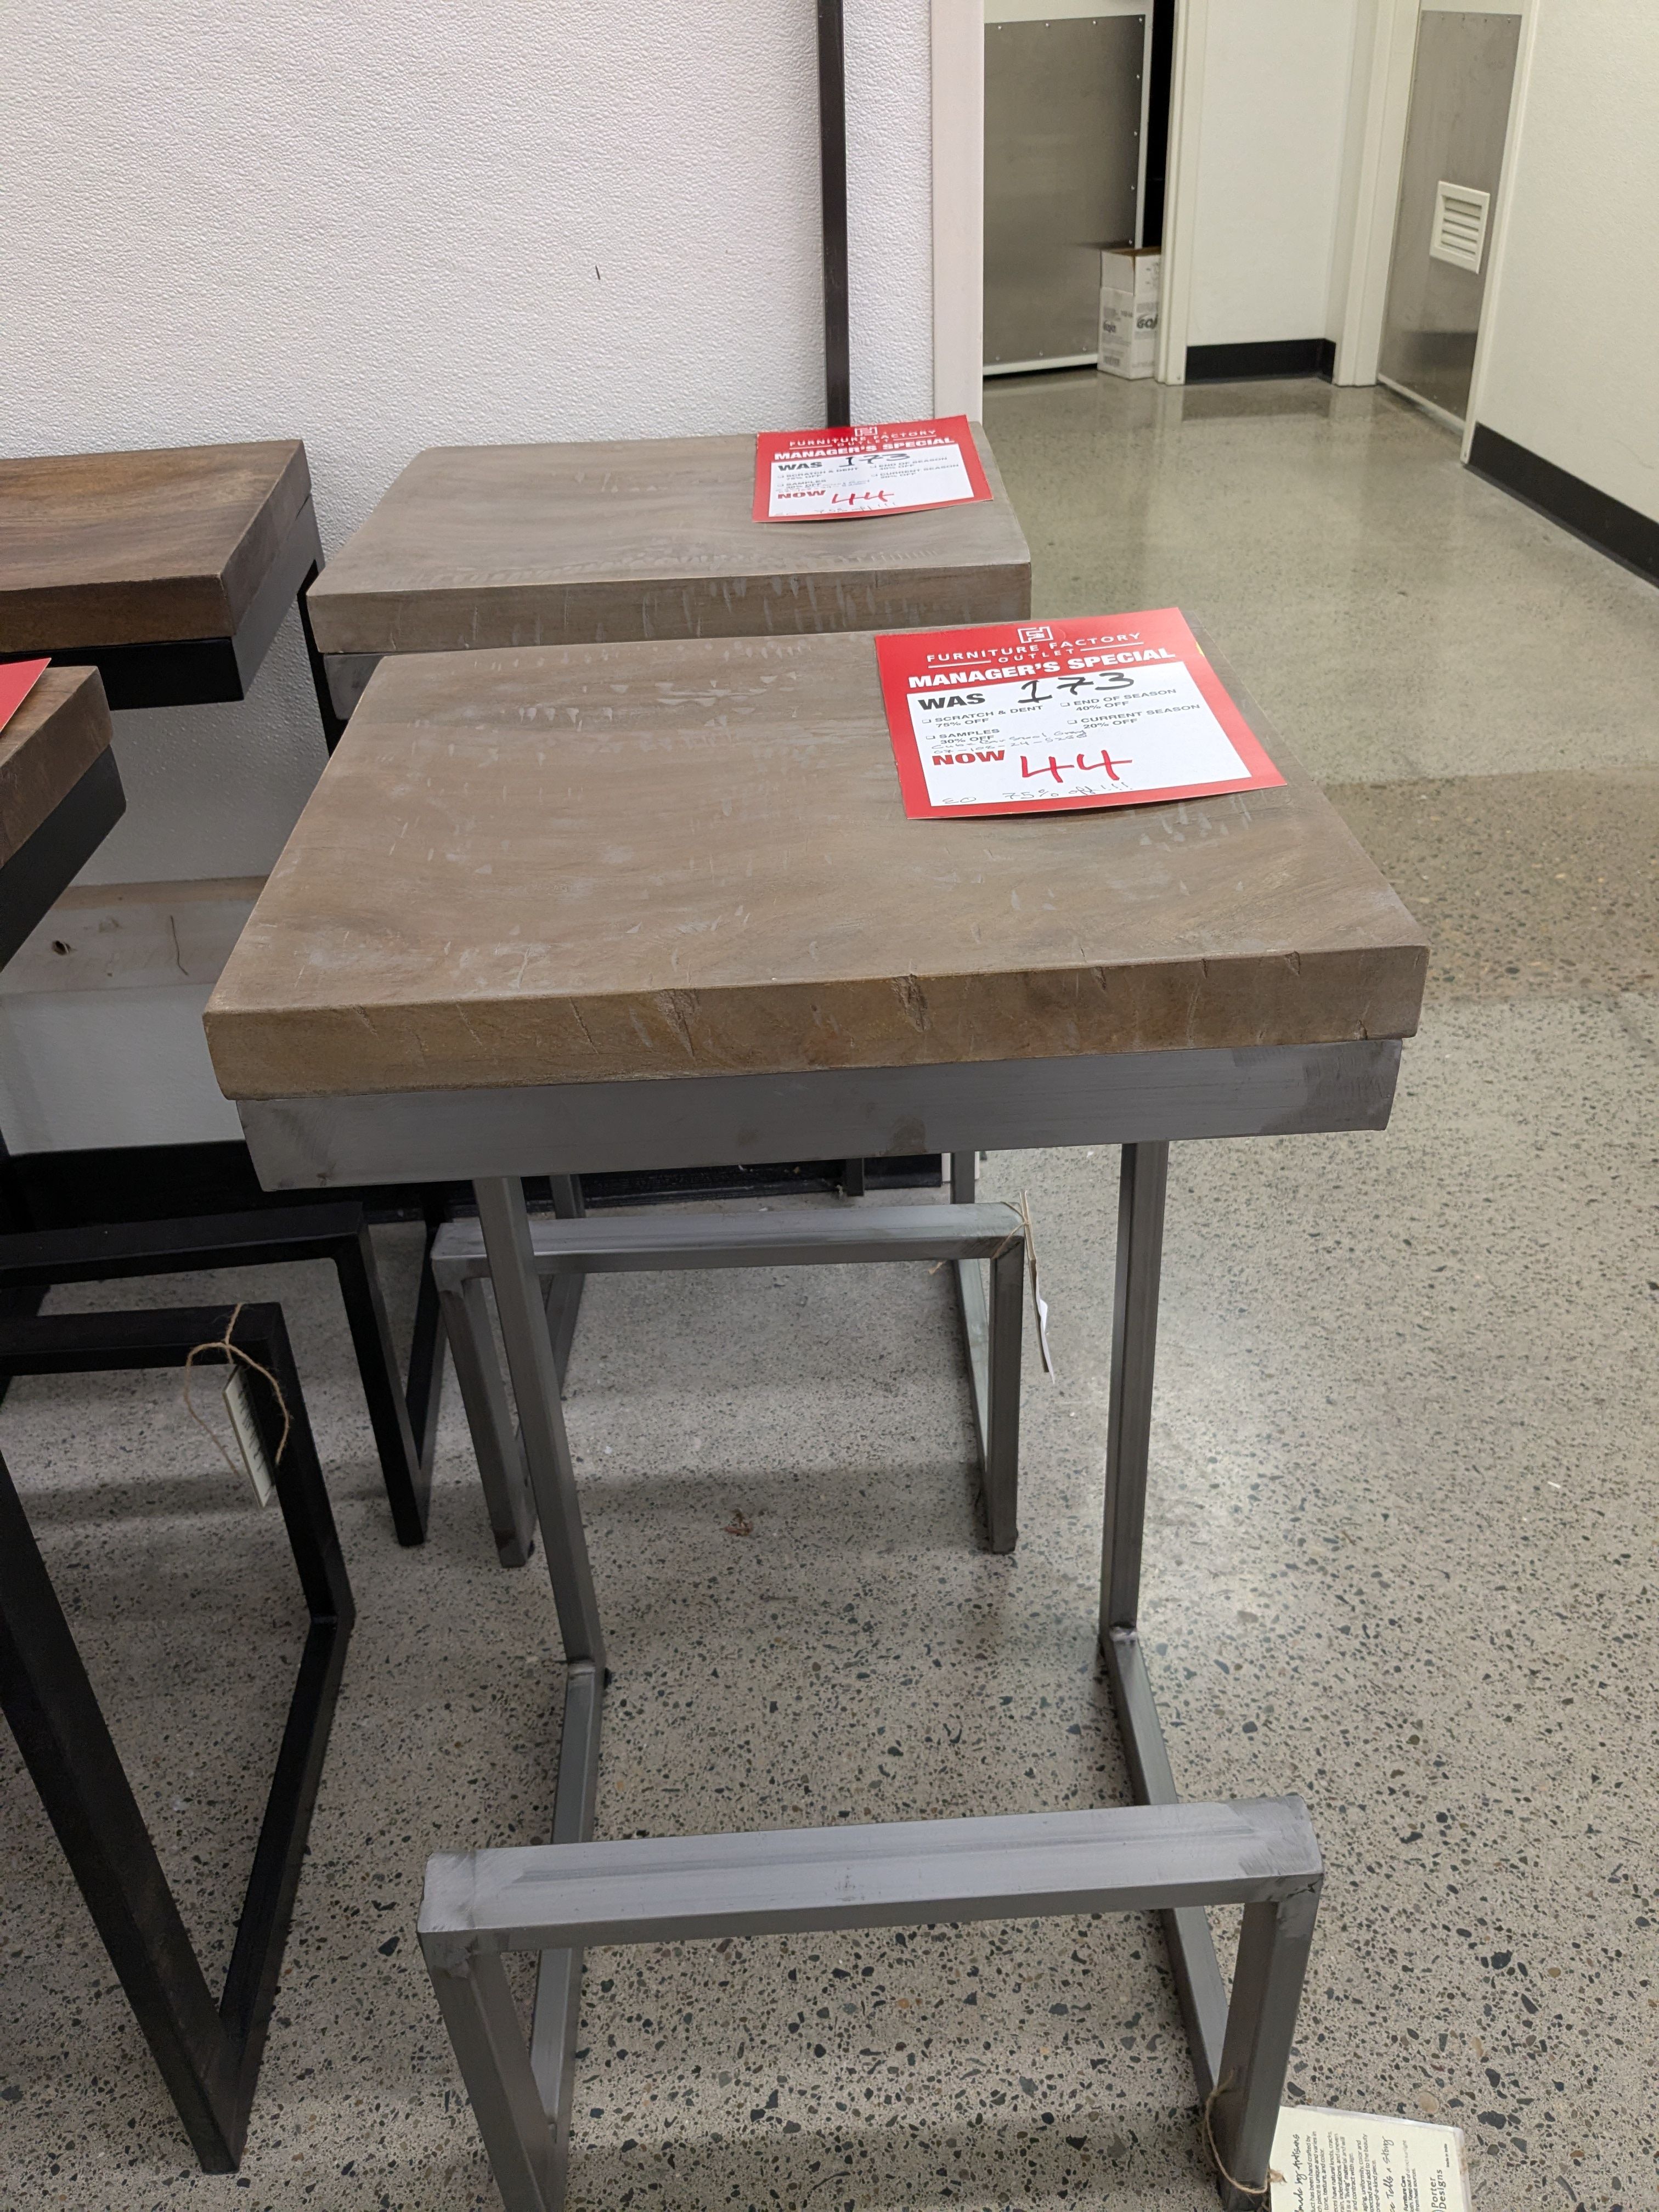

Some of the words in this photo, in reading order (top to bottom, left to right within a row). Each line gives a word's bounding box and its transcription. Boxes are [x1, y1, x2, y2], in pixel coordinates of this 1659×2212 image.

[774, 445, 877, 460] MANAGER'S
[882, 437, 955, 449] SPECIAL
[789, 436, 866, 447] FURNITURE
[873, 430, 936, 439] FACTORY
[778, 462, 822, 471] WAS
[839, 453, 910, 467] 173
[778, 490, 826, 499] NOW
[927, 645, 1039, 662] FURNITURE
[1049, 632, 1141, 649] FACTORY
[998, 648, 1074, 663] OUTLET
[909, 661, 1060, 689] MANAGER'S
[1068, 647, 1176, 669] SPECIAL
[918, 693, 985, 710] WAS
[1018, 672, 1134, 703] 173
[1124, 689, 1177, 699] SEASON
[935, 711, 994, 723] SCRATCH
[1010, 705, 1043, 714] DENT
[1081, 712, 1142, 723] CURRENT
[1146, 704, 1200, 715] SEASON
[939, 728, 1000, 739] SAMPLES
[932, 749, 1005, 765] NOW
[1020, 749, 1132, 783] 44
[1291, 2134, 1302, 2170] Artisans
[1381, 2136, 1394, 2164] Story
[1430, 2177, 1439, 2208] Porter
[1436, 2169, 1447, 2209] Designs
